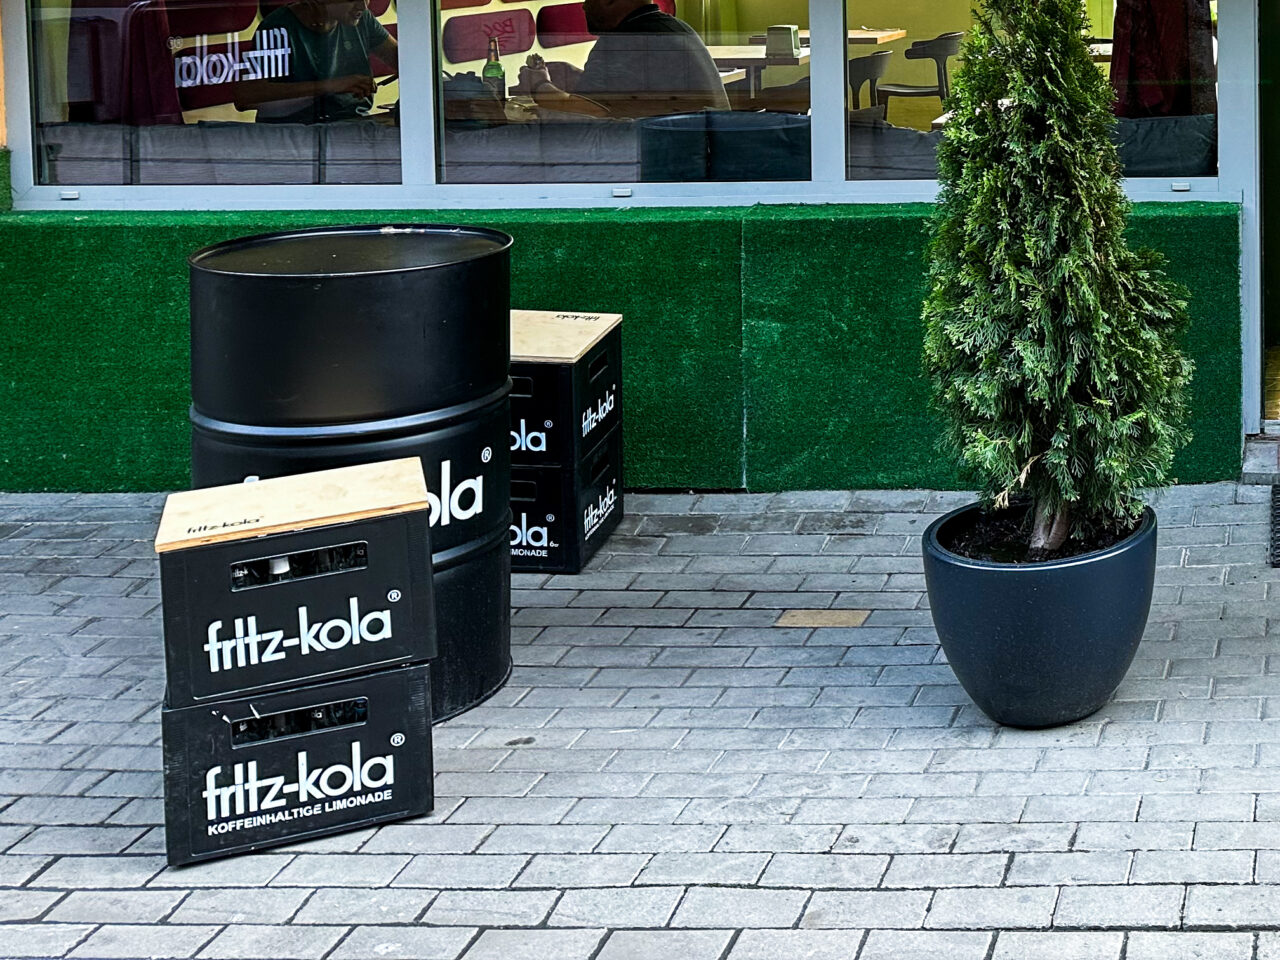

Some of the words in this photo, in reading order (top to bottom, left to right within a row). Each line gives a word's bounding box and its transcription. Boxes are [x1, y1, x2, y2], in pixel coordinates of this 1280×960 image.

[582, 390, 614, 438] fritz-kola
[584, 485, 614, 534] fritz-kola
[511, 548, 548, 557] MONADE
[203, 596, 393, 673] fritz-kola
[202, 741, 394, 821] fritz-kola
[207, 803, 322, 836] KOFFEINHALTIGE
[325, 789, 392, 813] LIMONADE
